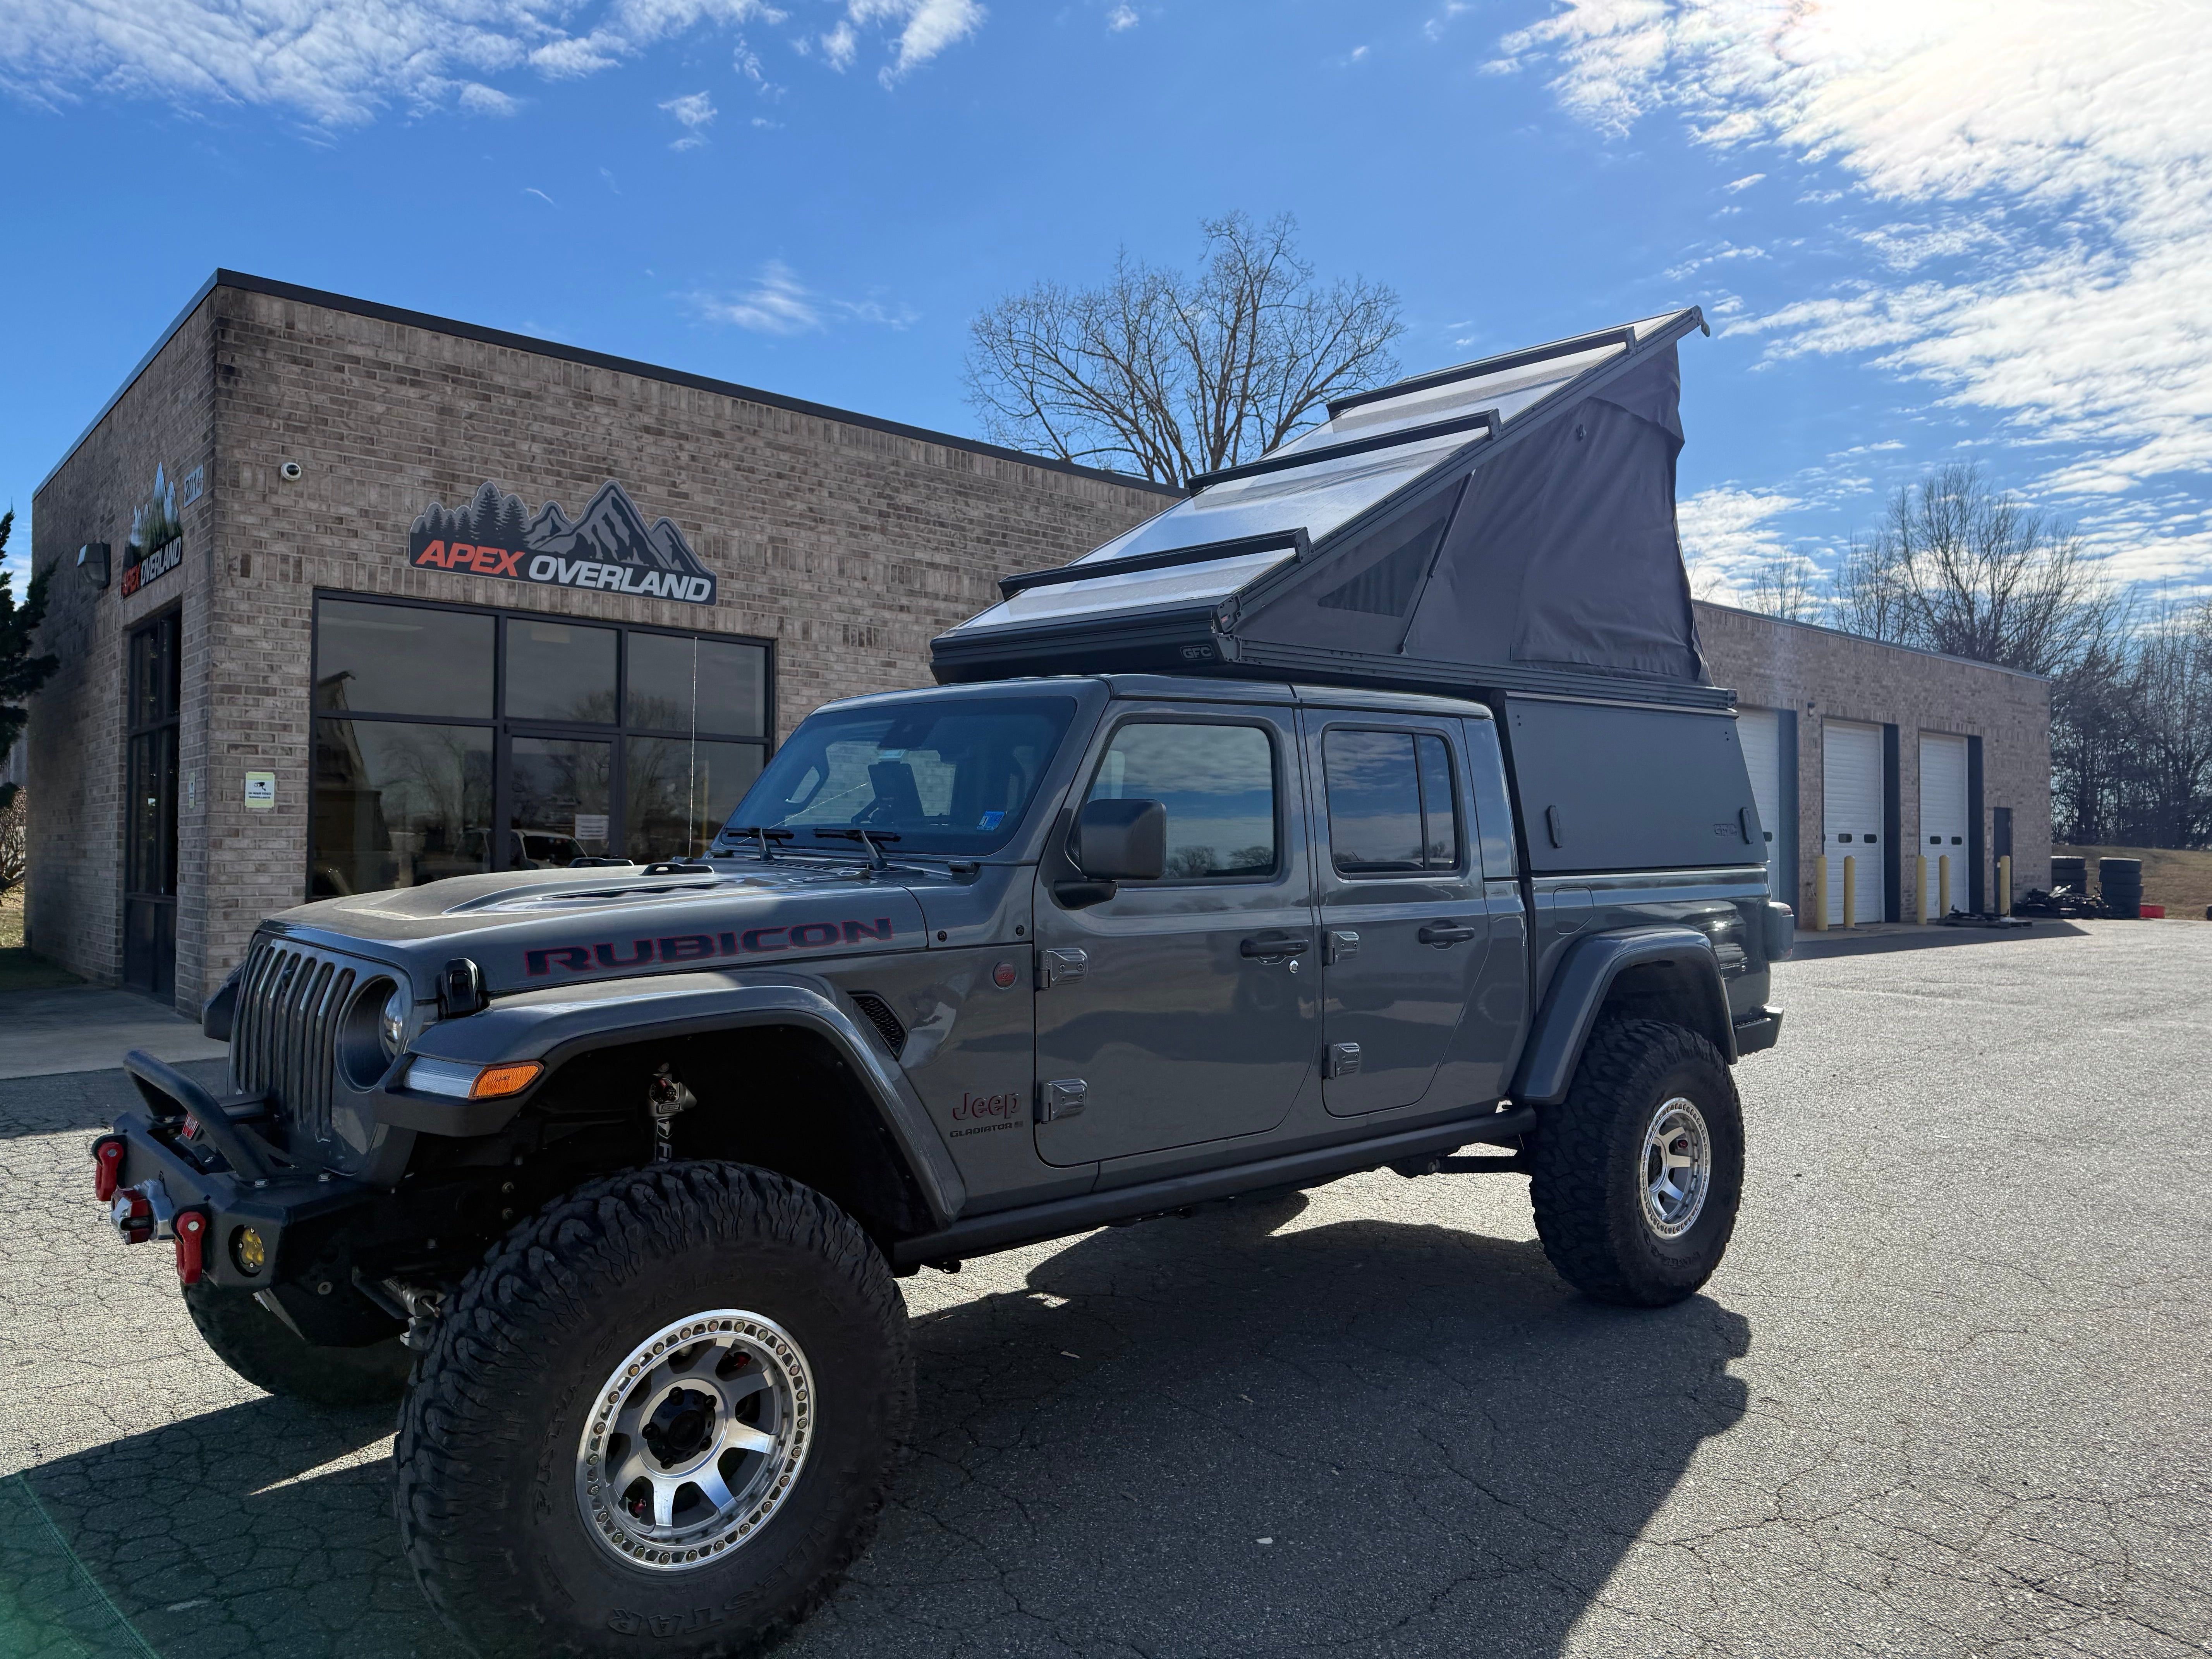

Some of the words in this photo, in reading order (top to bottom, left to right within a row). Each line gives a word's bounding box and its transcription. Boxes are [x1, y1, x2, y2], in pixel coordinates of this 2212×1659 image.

[141, 536, 181, 586] OVERLAND
[416, 540, 525, 577] APEX
[529, 555, 711, 602] OVERLAND
[1183, 646, 1212, 659] GFC
[525, 918, 893, 977] RUBICON
[953, 1092, 1022, 1120] Jeep
[950, 1122, 1012, 1138] GLADIATOR
